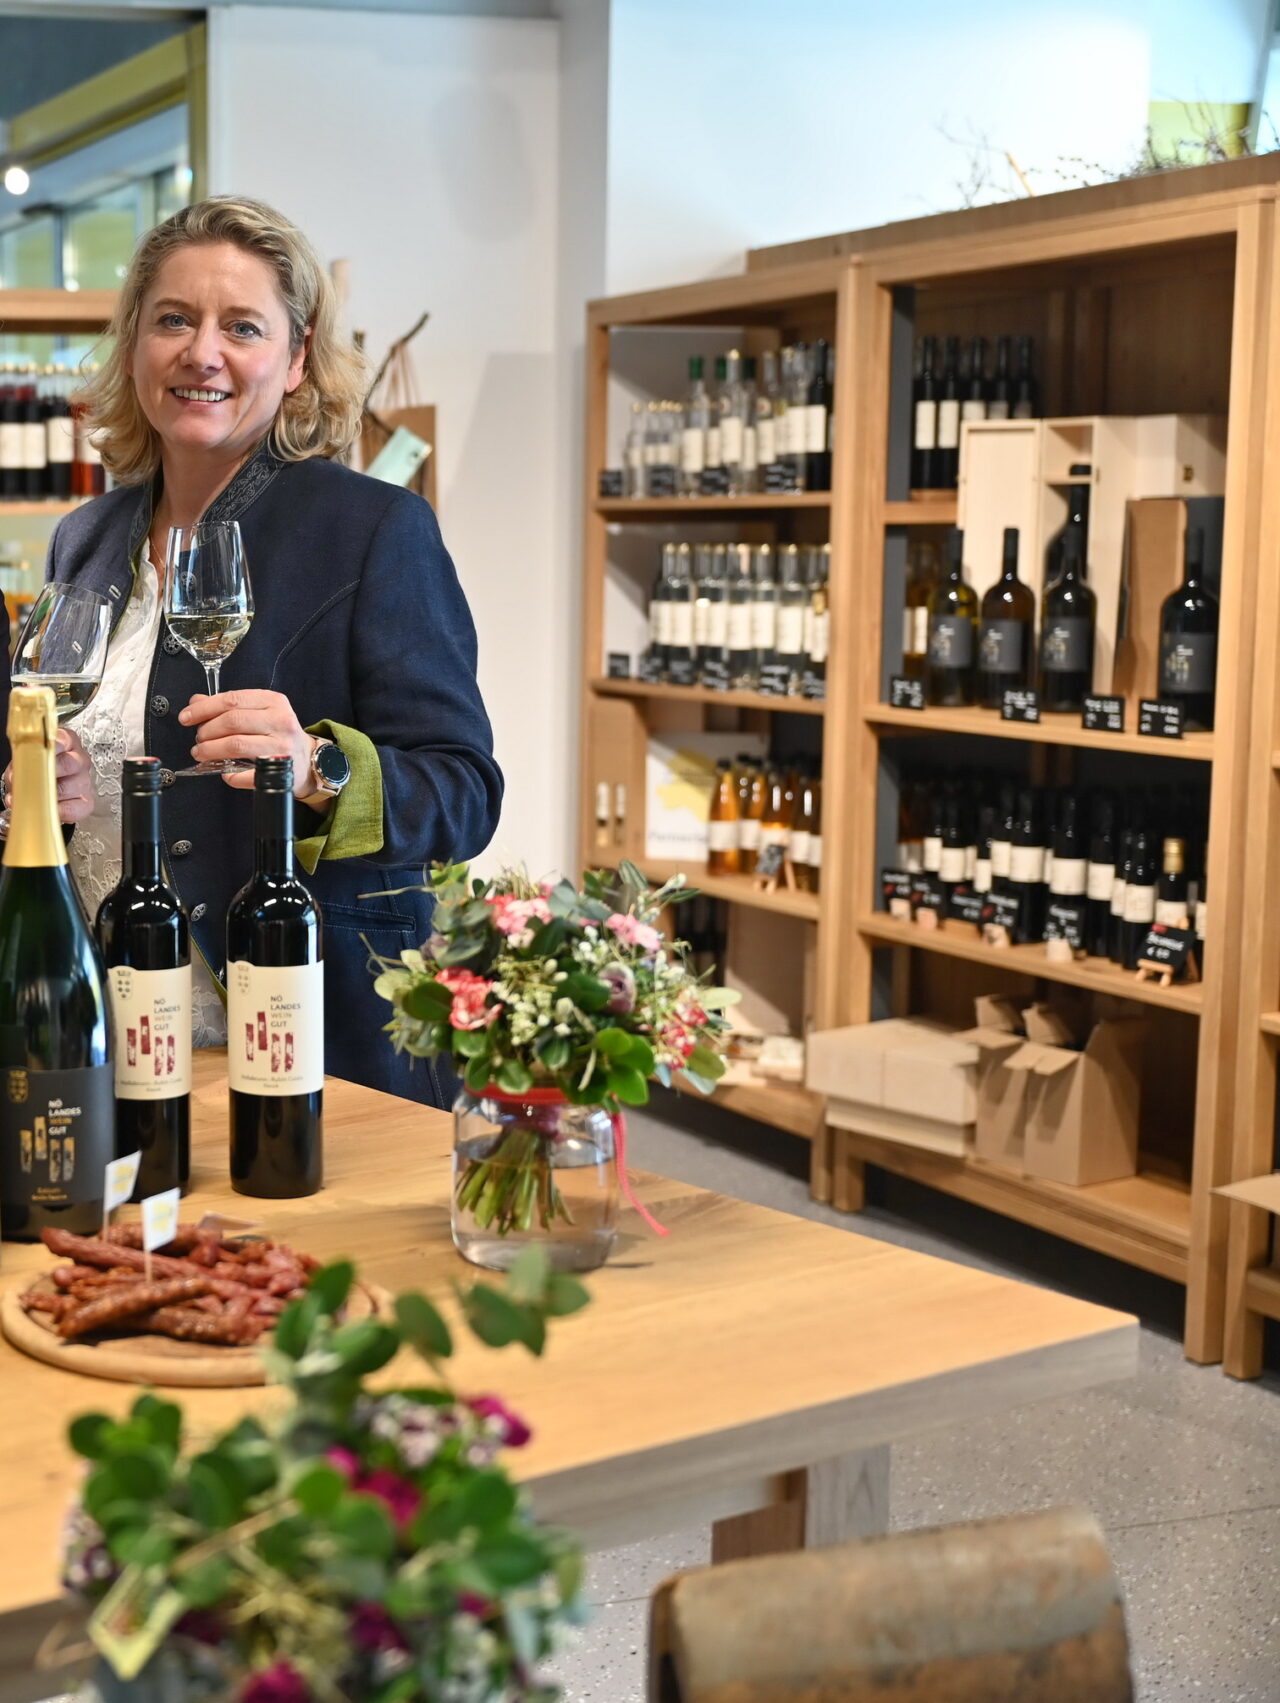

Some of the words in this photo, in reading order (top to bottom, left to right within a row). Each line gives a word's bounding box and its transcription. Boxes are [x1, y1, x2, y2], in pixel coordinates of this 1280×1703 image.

[154, 998, 166, 1006] NÖ
[270, 994, 283, 1002] NÖ
[154, 1006, 181, 1014] LANDES
[48, 1098, 63, 1108] NÖ
[48, 1106, 81, 1117] LANDES
[48, 1126, 66, 1135] GUT
